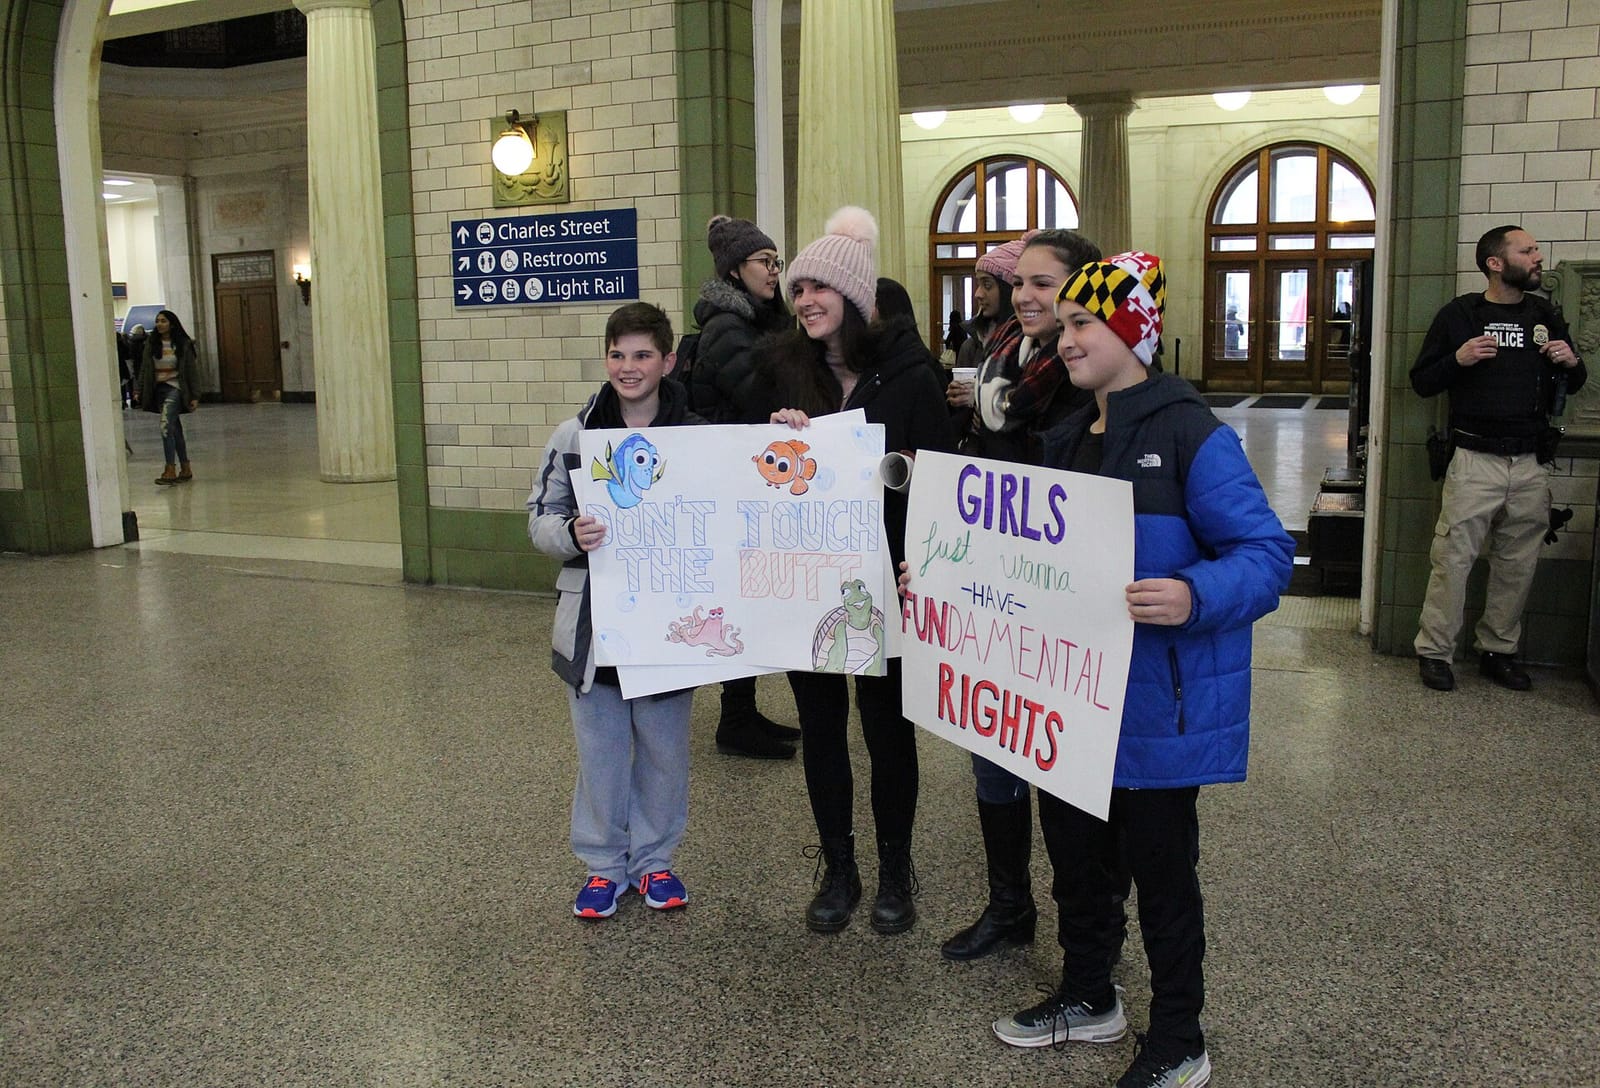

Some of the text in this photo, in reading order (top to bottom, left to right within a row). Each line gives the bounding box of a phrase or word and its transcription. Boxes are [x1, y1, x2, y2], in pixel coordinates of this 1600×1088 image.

[498, 218, 610, 240] Charles Street
[523, 250, 607, 268] Restrooms
[547, 276, 625, 299] Light Rail
[585, 494, 880, 552] DON'T TOUCH
[957, 463, 1067, 545] GIRLS
[615, 547, 862, 601] THE BUTT
[901, 588, 1110, 711] FUNDAMENTAL
[937, 662, 1064, 772] RIGHTS
